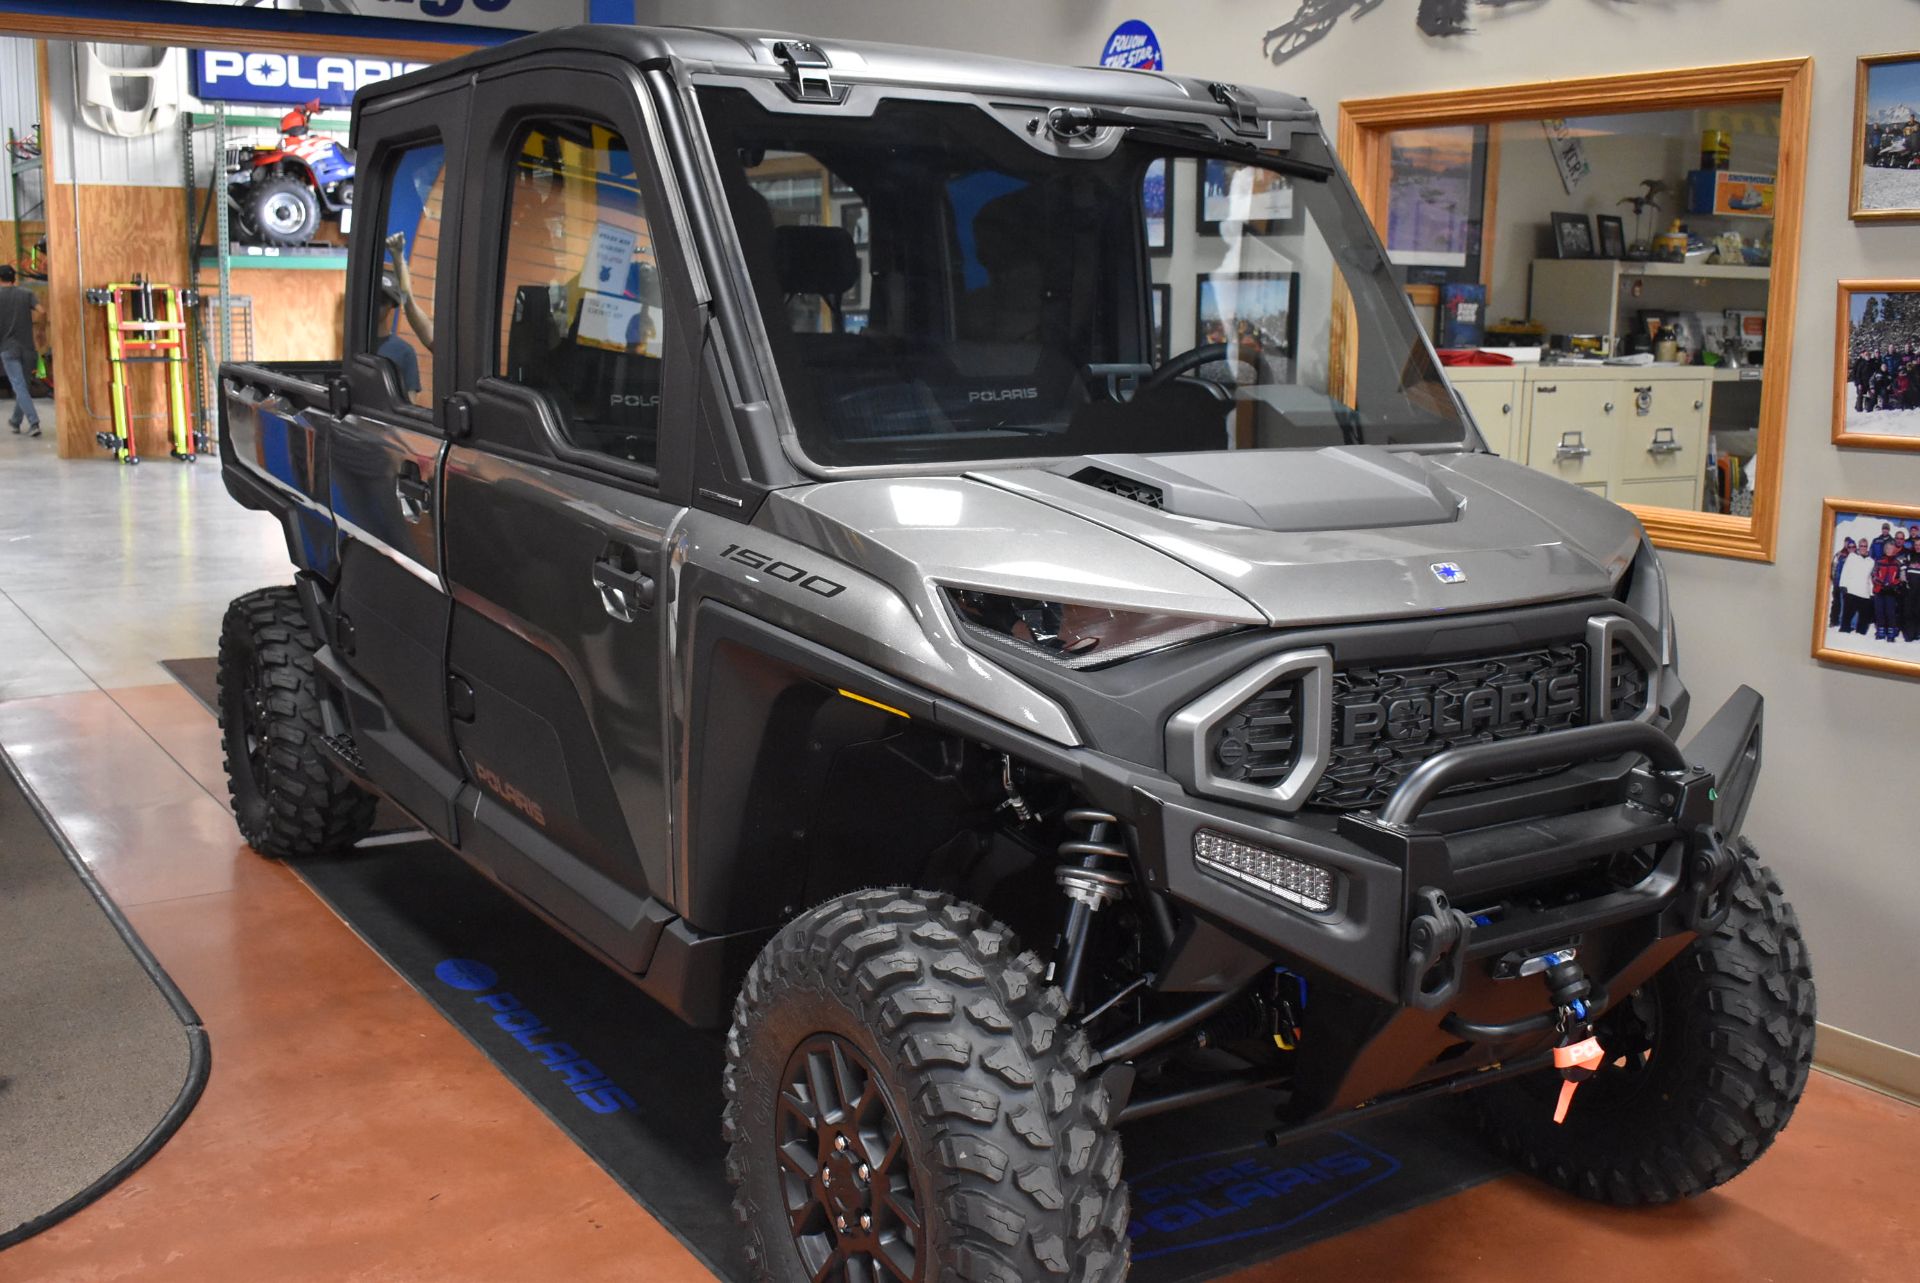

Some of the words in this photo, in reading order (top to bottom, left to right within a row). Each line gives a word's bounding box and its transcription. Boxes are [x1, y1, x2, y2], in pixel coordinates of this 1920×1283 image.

[1109, 34, 1148, 55] FOLLOW
[1126, 45, 1153, 66] STAR
[967, 387, 1038, 403] POLARIS
[719, 543, 848, 598] 1500
[1343, 674, 1581, 746] POLARIS
[474, 761, 546, 828] POLARIS
[473, 991, 642, 1115] POLARIS
